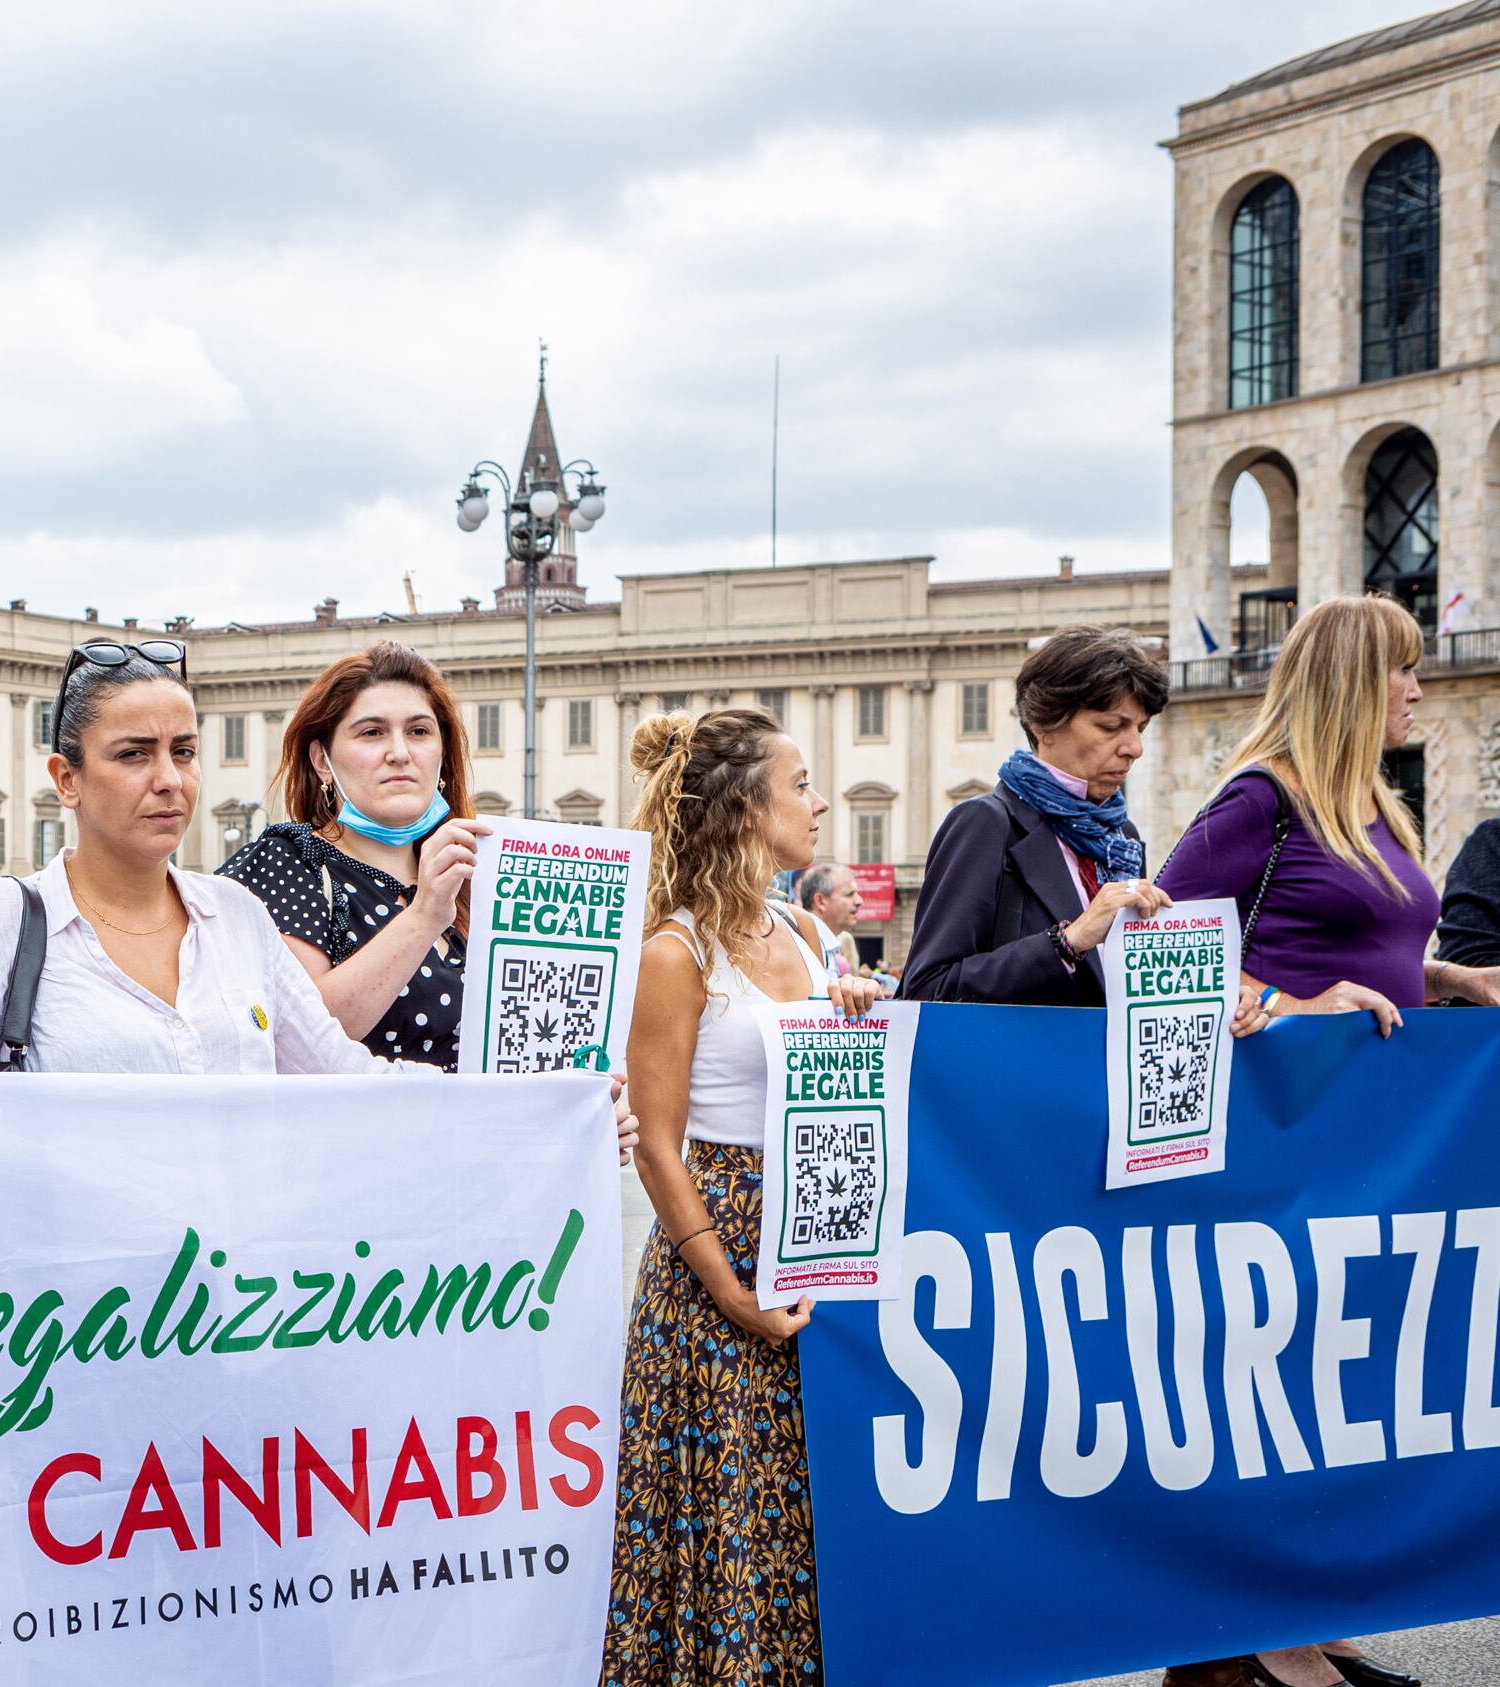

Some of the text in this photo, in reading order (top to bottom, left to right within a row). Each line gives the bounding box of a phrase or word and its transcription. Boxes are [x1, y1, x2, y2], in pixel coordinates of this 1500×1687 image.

[501, 838, 630, 863] FIRMA ORA ONLINE
[499, 855, 629, 885] REFERENDUM
[496, 876, 626, 909] CANNABIS
[491, 900, 624, 940] LEGALE
[1124, 916, 1223, 932] FIRMA ORA ONLINE
[1124, 930, 1224, 950] REFERENDUM
[1125, 946, 1224, 971] CANNABIS
[1125, 966, 1225, 998] LEGALE
[779, 1018, 816, 1030] FIRMA
[818, 1018, 841, 1030] ORA
[784, 1032, 885, 1050] REFERENDUM
[786, 1051, 884, 1072] CANNABIS
[786, 1072, 885, 1101] LEGALE
[775, 1260, 879, 1276] INFORMATI E FIRMA SUL SITO
[776, 1272, 874, 1290] ReferendumCannabis.it
[27, 1405, 604, 1566] CANNABIS
[350, 1560, 400, 1600] HA
[412, 1543, 570, 1591] FALLITO
